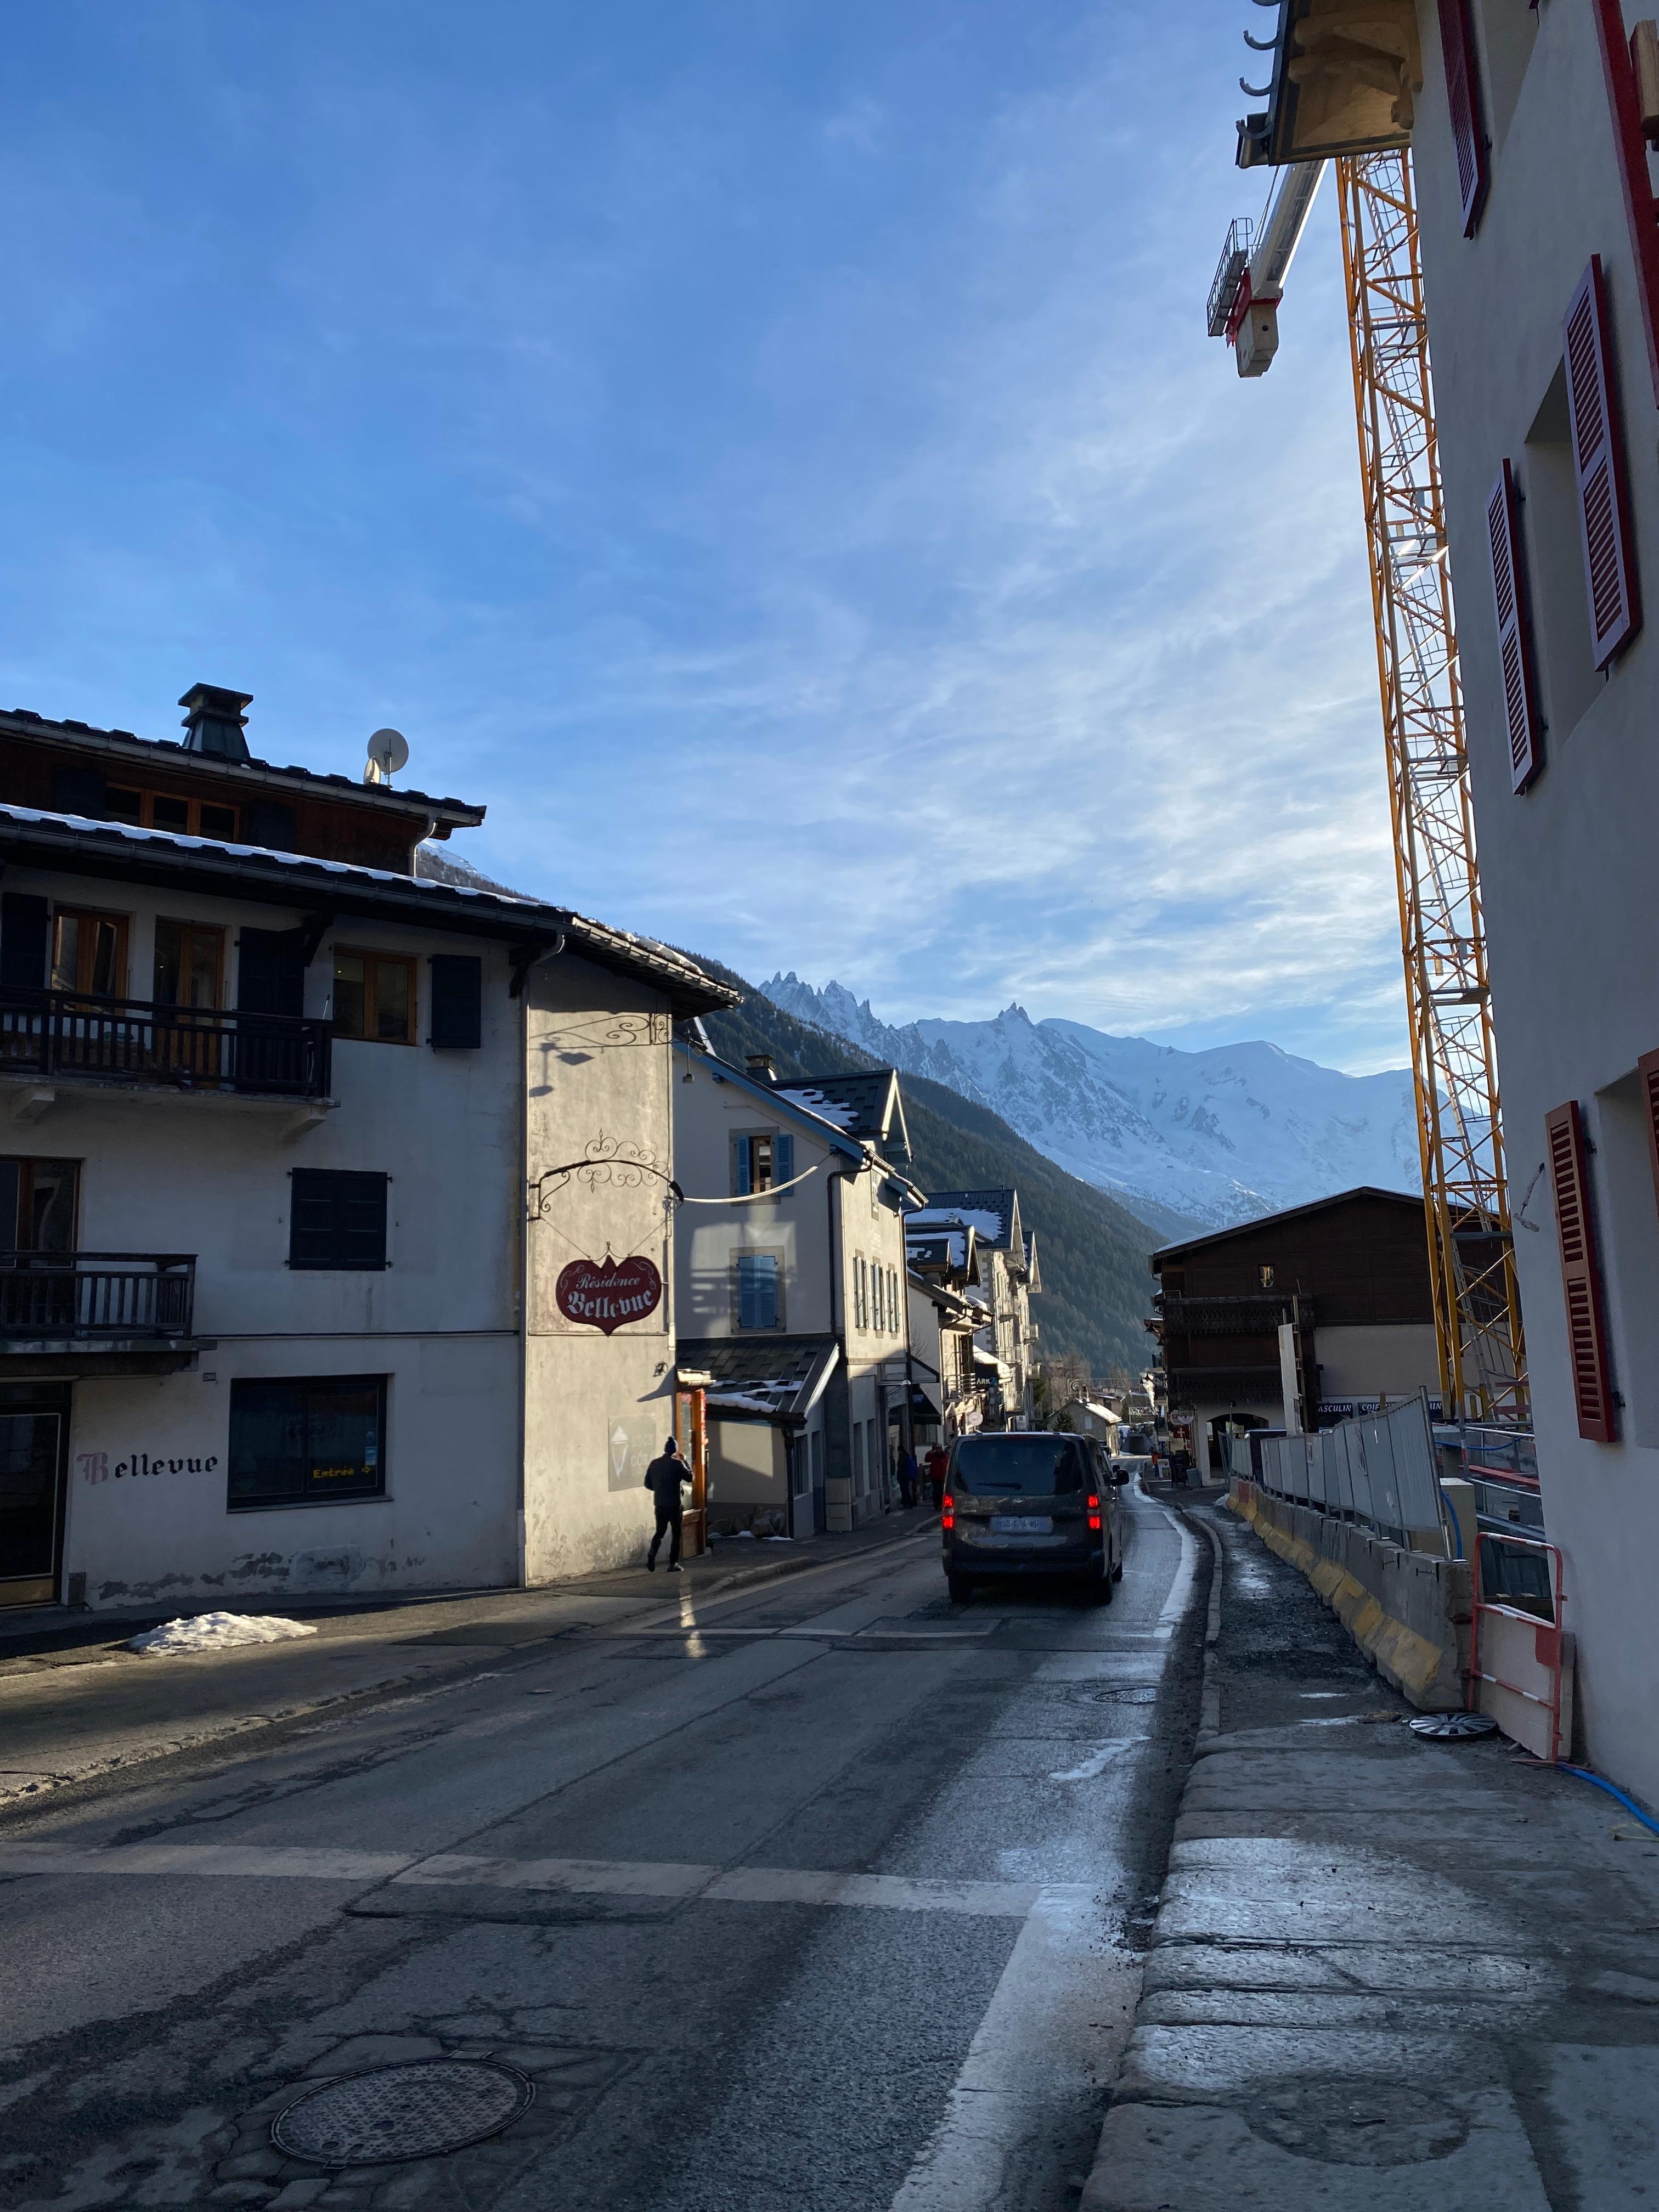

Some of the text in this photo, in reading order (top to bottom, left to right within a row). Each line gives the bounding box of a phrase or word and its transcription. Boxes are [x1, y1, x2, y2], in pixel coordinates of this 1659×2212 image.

[576, 1272, 641, 1289] Résidence
[567, 1290, 653, 1319] Bellevue
[76, 1452, 217, 1486] Bellevue
[313, 1466, 354, 1479] Entrée
